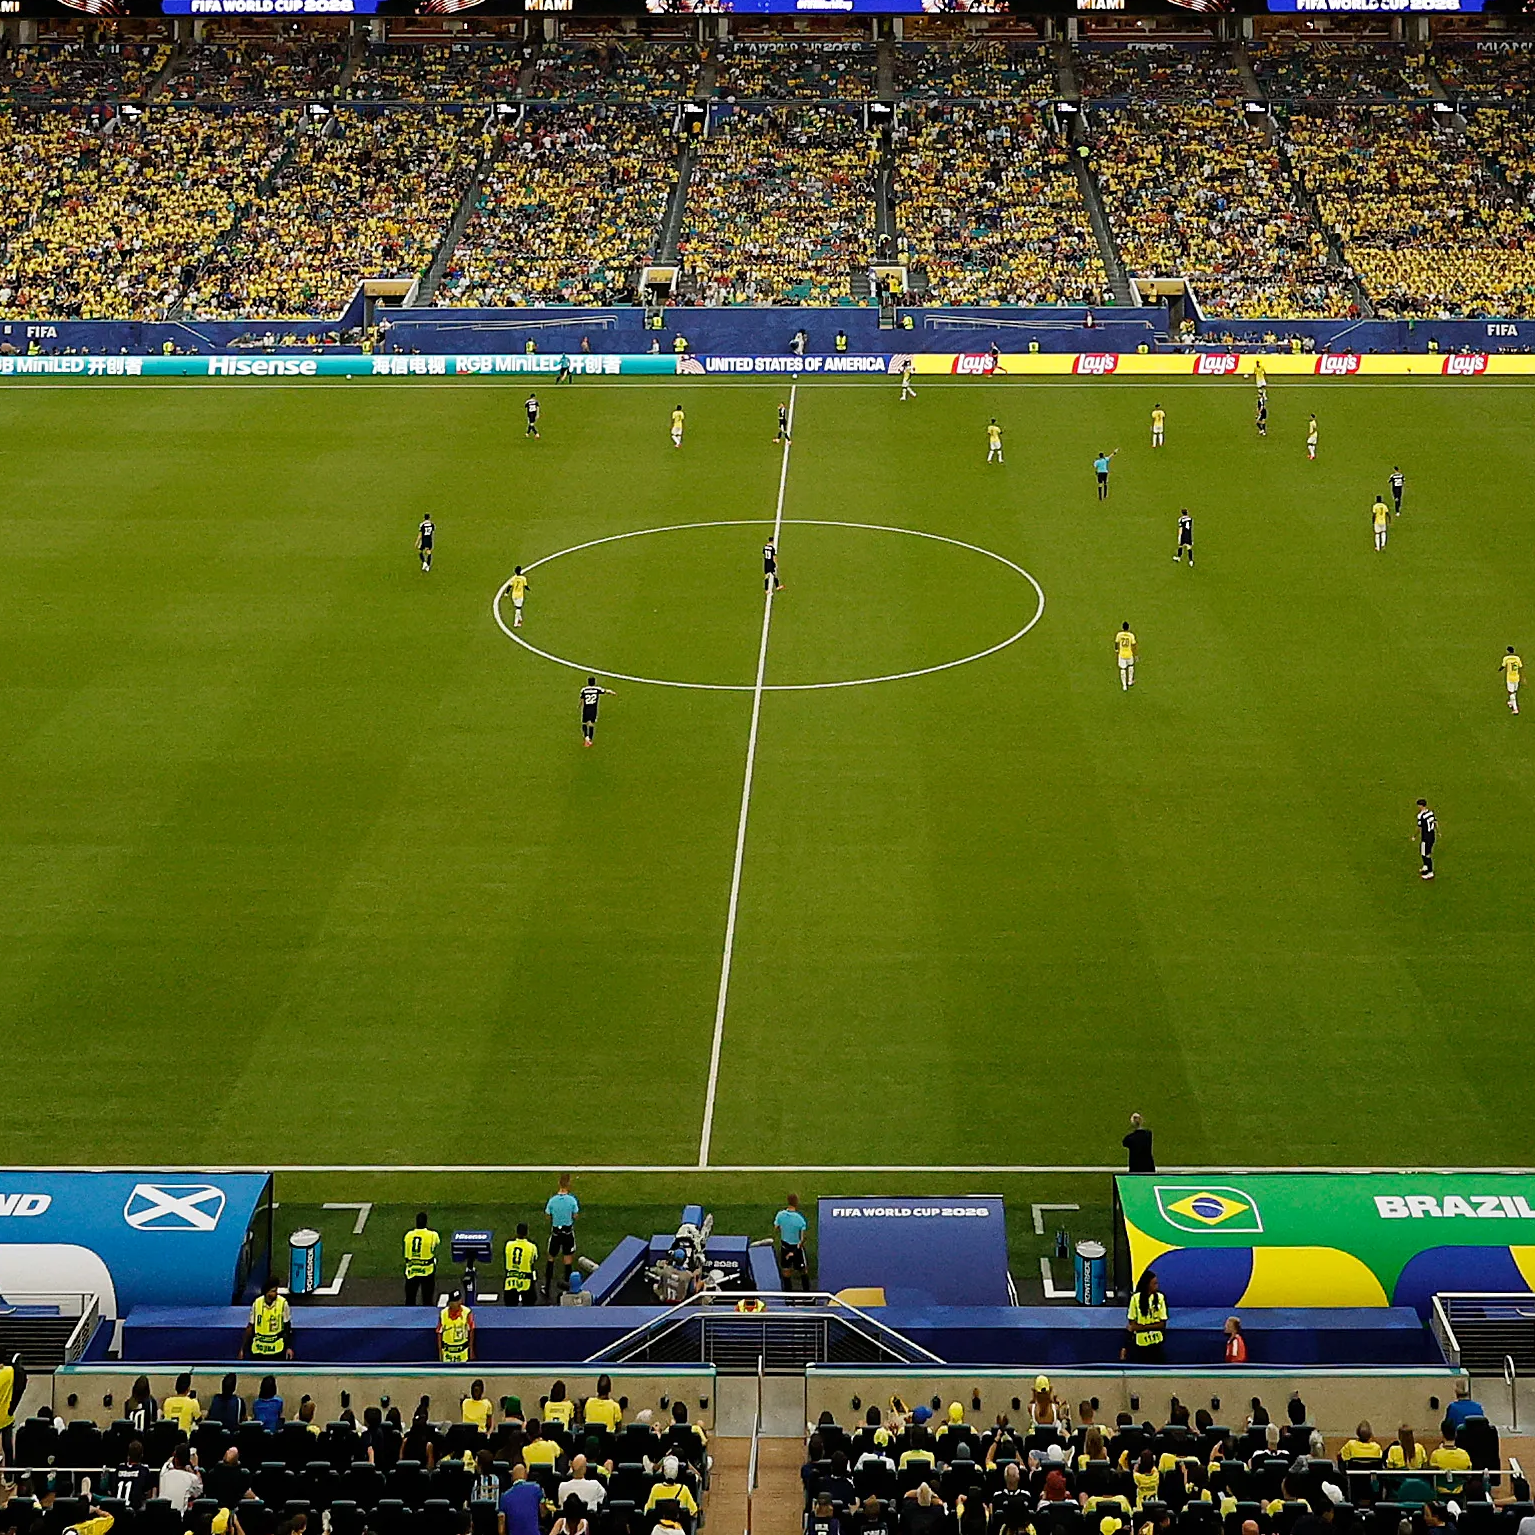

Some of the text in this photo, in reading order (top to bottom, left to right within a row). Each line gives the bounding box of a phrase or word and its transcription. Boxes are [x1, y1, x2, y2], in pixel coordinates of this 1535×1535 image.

[191, 0, 354, 13] FIFA WORLD CUP 2026
[524, 0, 573, 11] MIAMI
[26, 325, 58, 339] FIFA
[1487, 324, 1518, 336] FIFA
[16, 356, 85, 374] MiniLED
[87, 356, 143, 376] 开创者
[206, 355, 622, 376] Hisense 海信电视 RGB MiniLED 开创者
[706, 357, 885, 371] UNITED STATES OF AMERICA
[956, 354, 994, 375] Lay's
[1077, 354, 1116, 375] Lay's
[1198, 354, 1236, 375] Lay's
[1320, 354, 1359, 375] Lay's
[1447, 355, 1486, 375] Lay's
[585, 694, 597, 705] 22
[832, 1207, 989, 1217] FIFA WORLD CUP 2026
[454, 1232, 487, 1240] Hisense
[117, 1481, 133, 1506] 11
